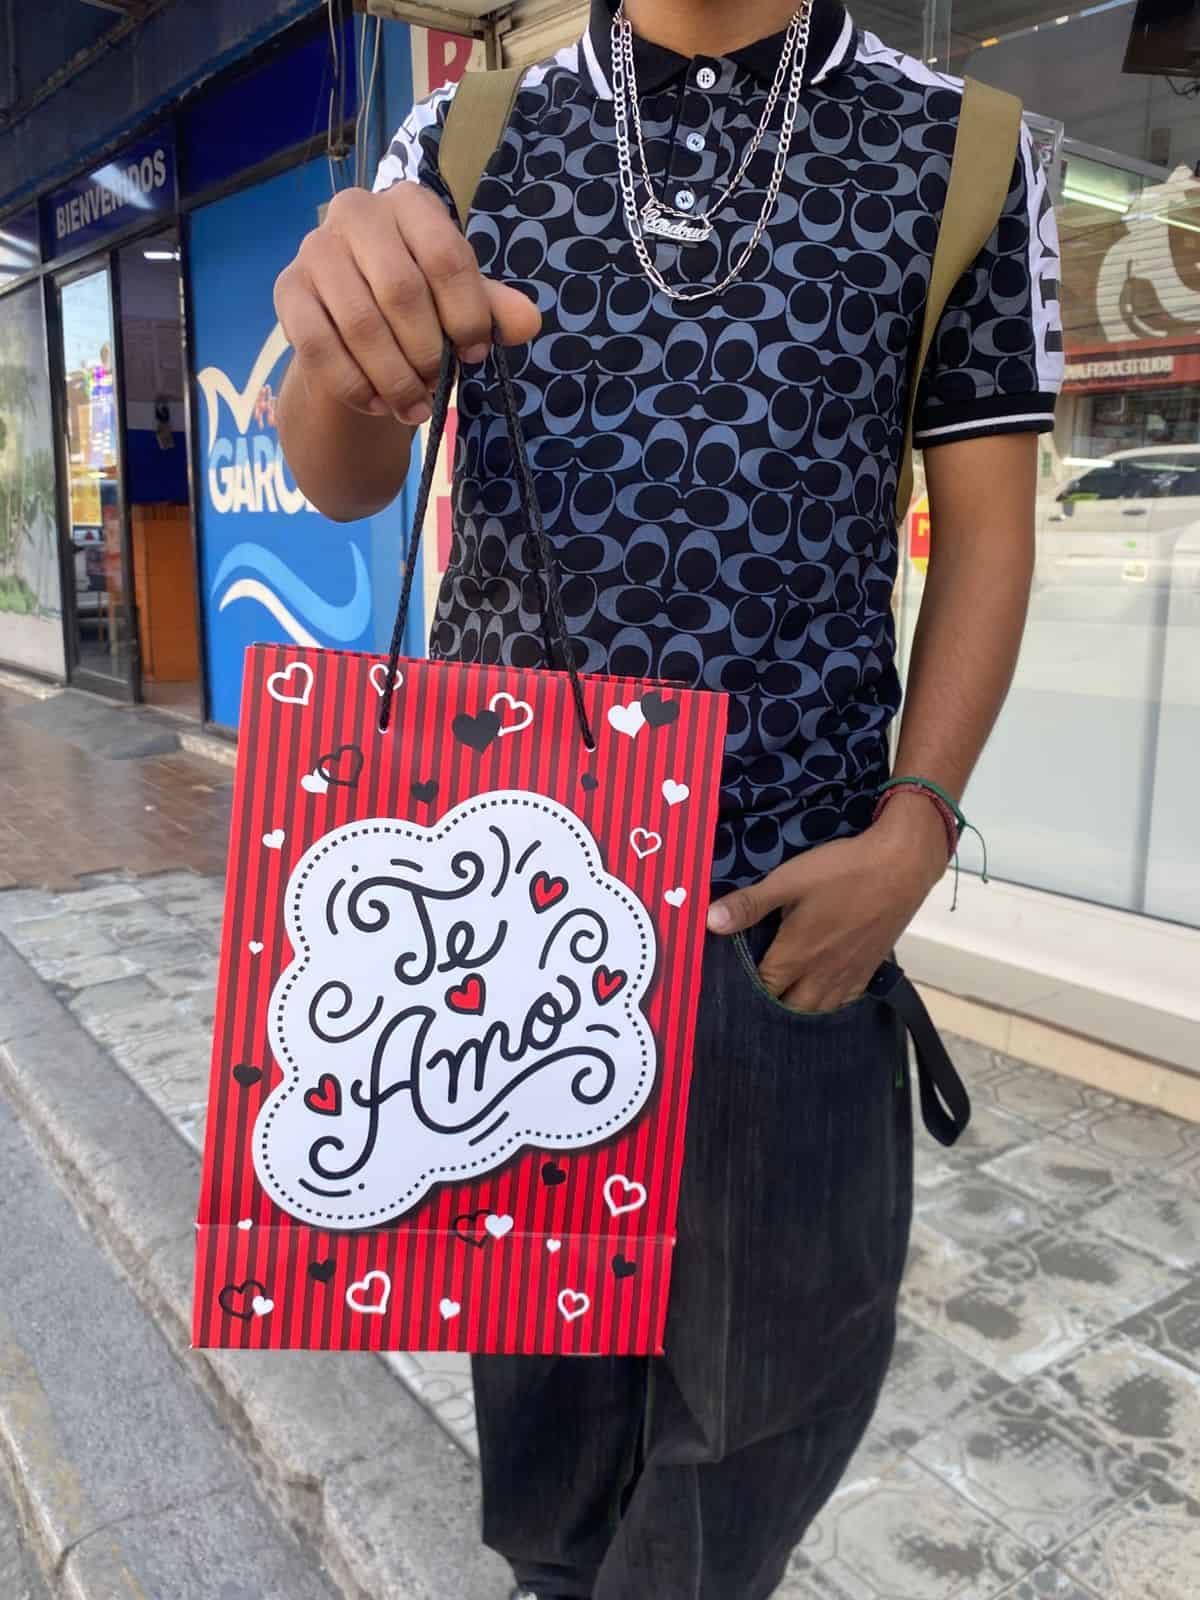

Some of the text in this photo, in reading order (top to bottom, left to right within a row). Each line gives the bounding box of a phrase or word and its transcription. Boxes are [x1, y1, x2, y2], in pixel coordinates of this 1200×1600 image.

[56, 149, 166, 240] BIENVENIDOS
[348, 850, 508, 985] Te
[308, 975, 616, 1180] Amo
